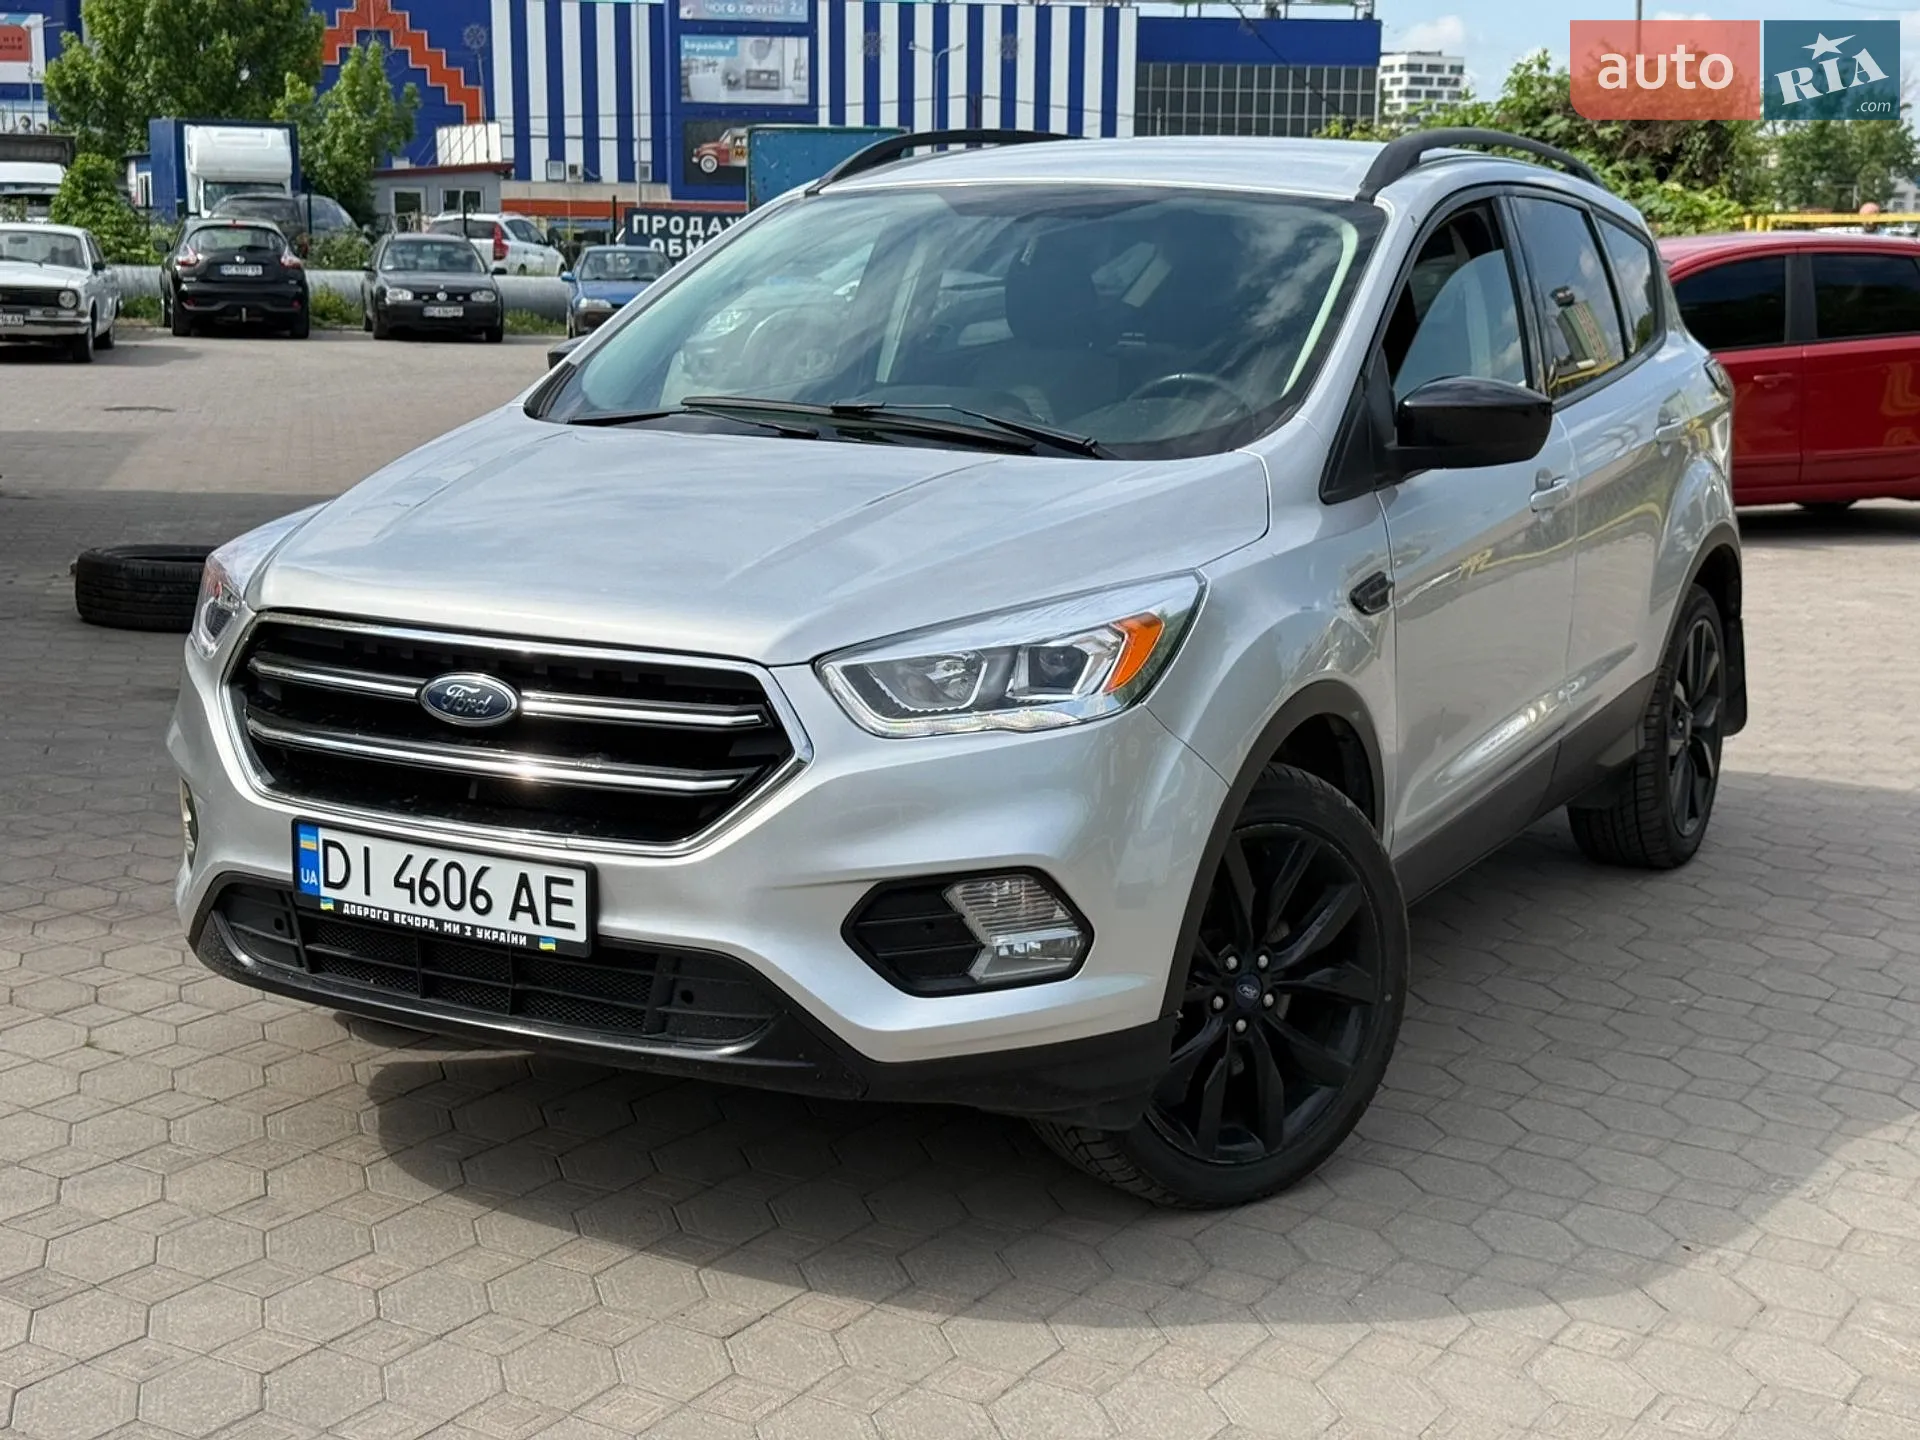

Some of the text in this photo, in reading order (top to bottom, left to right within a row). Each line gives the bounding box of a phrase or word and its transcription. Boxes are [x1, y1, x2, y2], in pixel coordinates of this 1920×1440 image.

[440, 684, 493, 715] Ford
[301, 867, 319, 886] UA
[321, 838, 576, 931] DI 4606 AE
[342, 902, 390, 922] ДОБРОГО
[393, 912, 440, 932] ВЕЧОРА,
[443, 922, 460, 935] МИ
[476, 926, 527, 946] УКРАЇНИ
